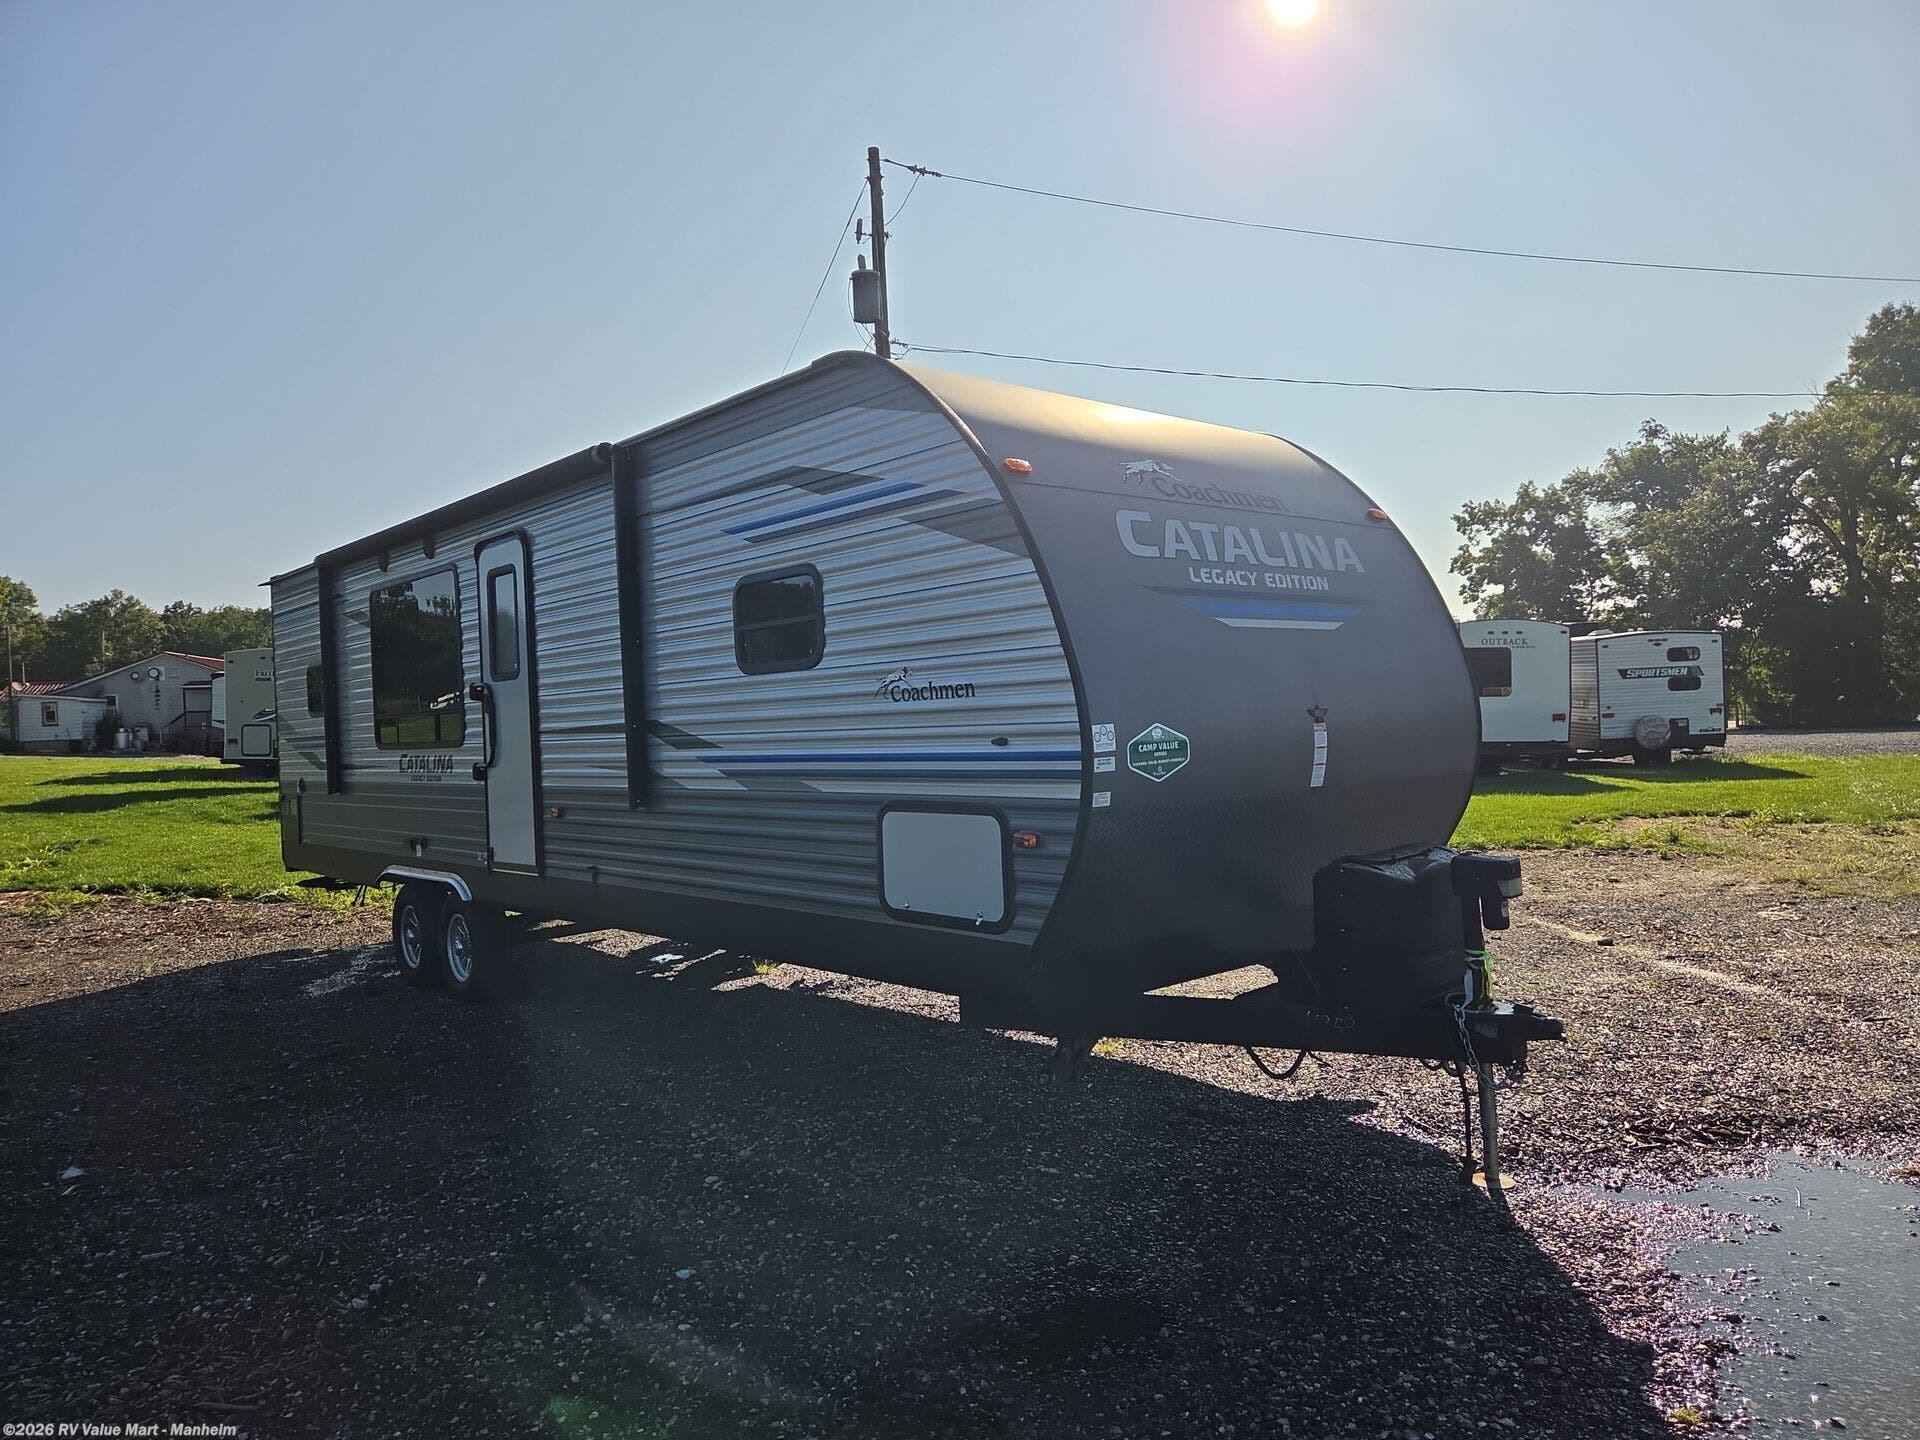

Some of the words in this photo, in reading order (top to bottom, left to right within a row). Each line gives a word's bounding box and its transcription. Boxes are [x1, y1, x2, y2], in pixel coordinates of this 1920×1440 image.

[1151, 477, 1290, 512] Coachmen
[1115, 509, 1366, 573] CATALINA
[1188, 566, 1258, 586] LEGACY
[1264, 571, 1330, 591] EDITION
[1481, 638, 1529, 646] OUTBACK
[1626, 666, 1688, 678] SPORTSMEN
[890, 681, 976, 703] Coachmen
[1138, 743, 1158, 753] CAMP
[1158, 741, 1179, 751] VALUE
[399, 754, 454, 774] CATALINA
